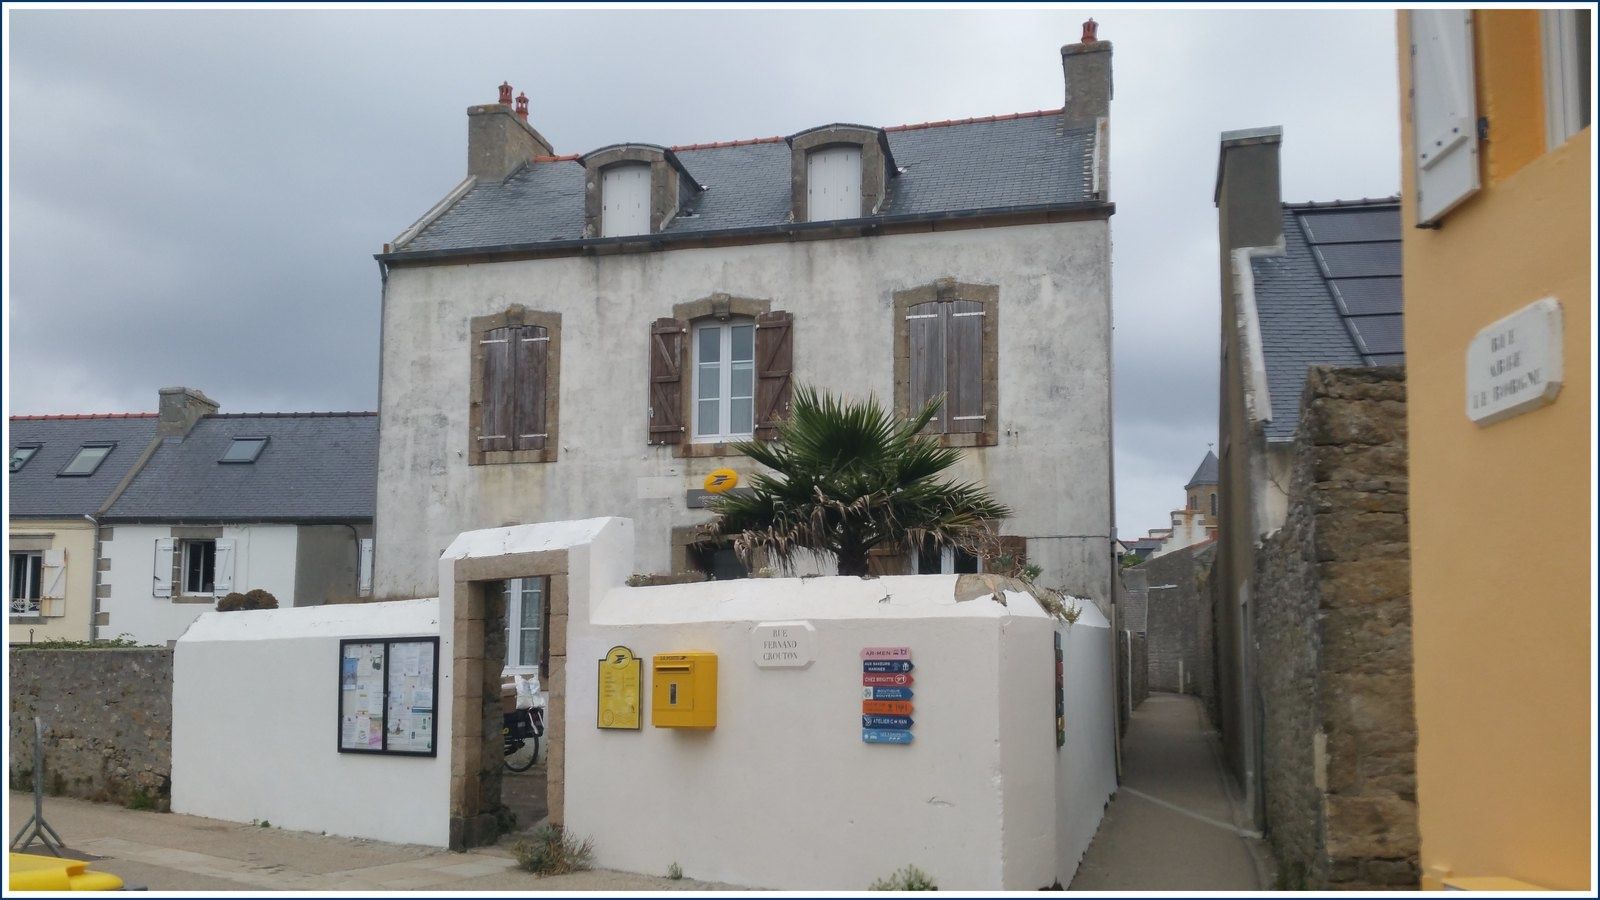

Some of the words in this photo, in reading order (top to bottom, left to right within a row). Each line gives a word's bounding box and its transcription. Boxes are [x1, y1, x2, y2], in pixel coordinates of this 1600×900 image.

[772, 629, 788, 638] RUE
[763, 640, 798, 649] FERNAND
[763, 651, 798, 661] CROUTON
